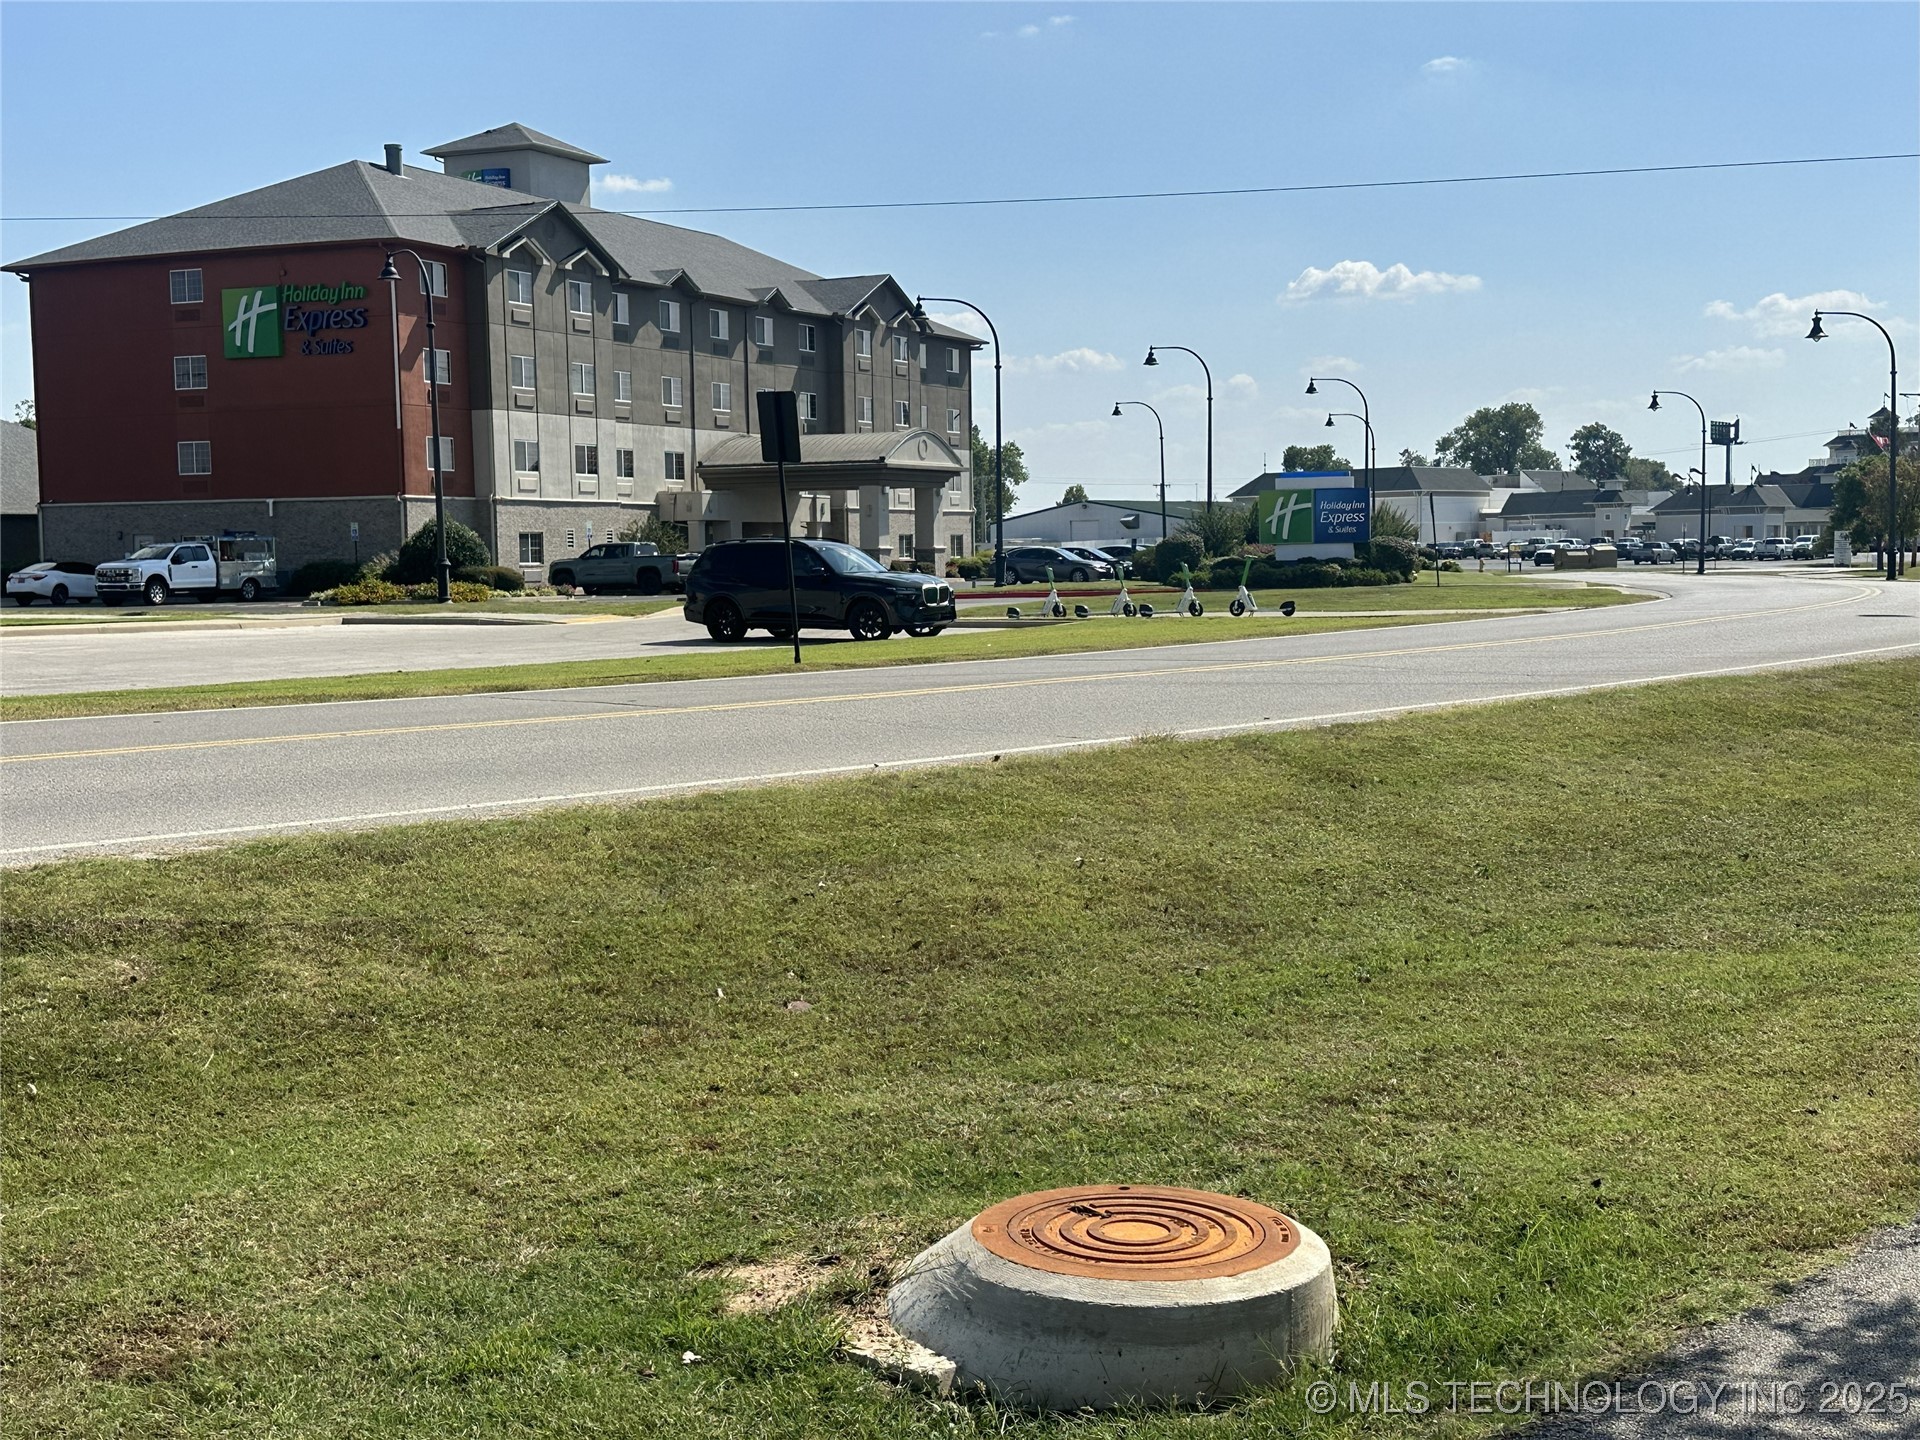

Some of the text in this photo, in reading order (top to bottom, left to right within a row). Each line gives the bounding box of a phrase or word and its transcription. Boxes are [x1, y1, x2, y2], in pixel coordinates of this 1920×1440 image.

[282, 281, 364, 305] Holiday Inn
[284, 305, 367, 336] Express
[302, 339, 353, 354] & Suites
[1320, 500, 1365, 511] Holiday Inn
[1320, 511, 1365, 525] Express
[1328, 525, 1357, 534] & Suites
